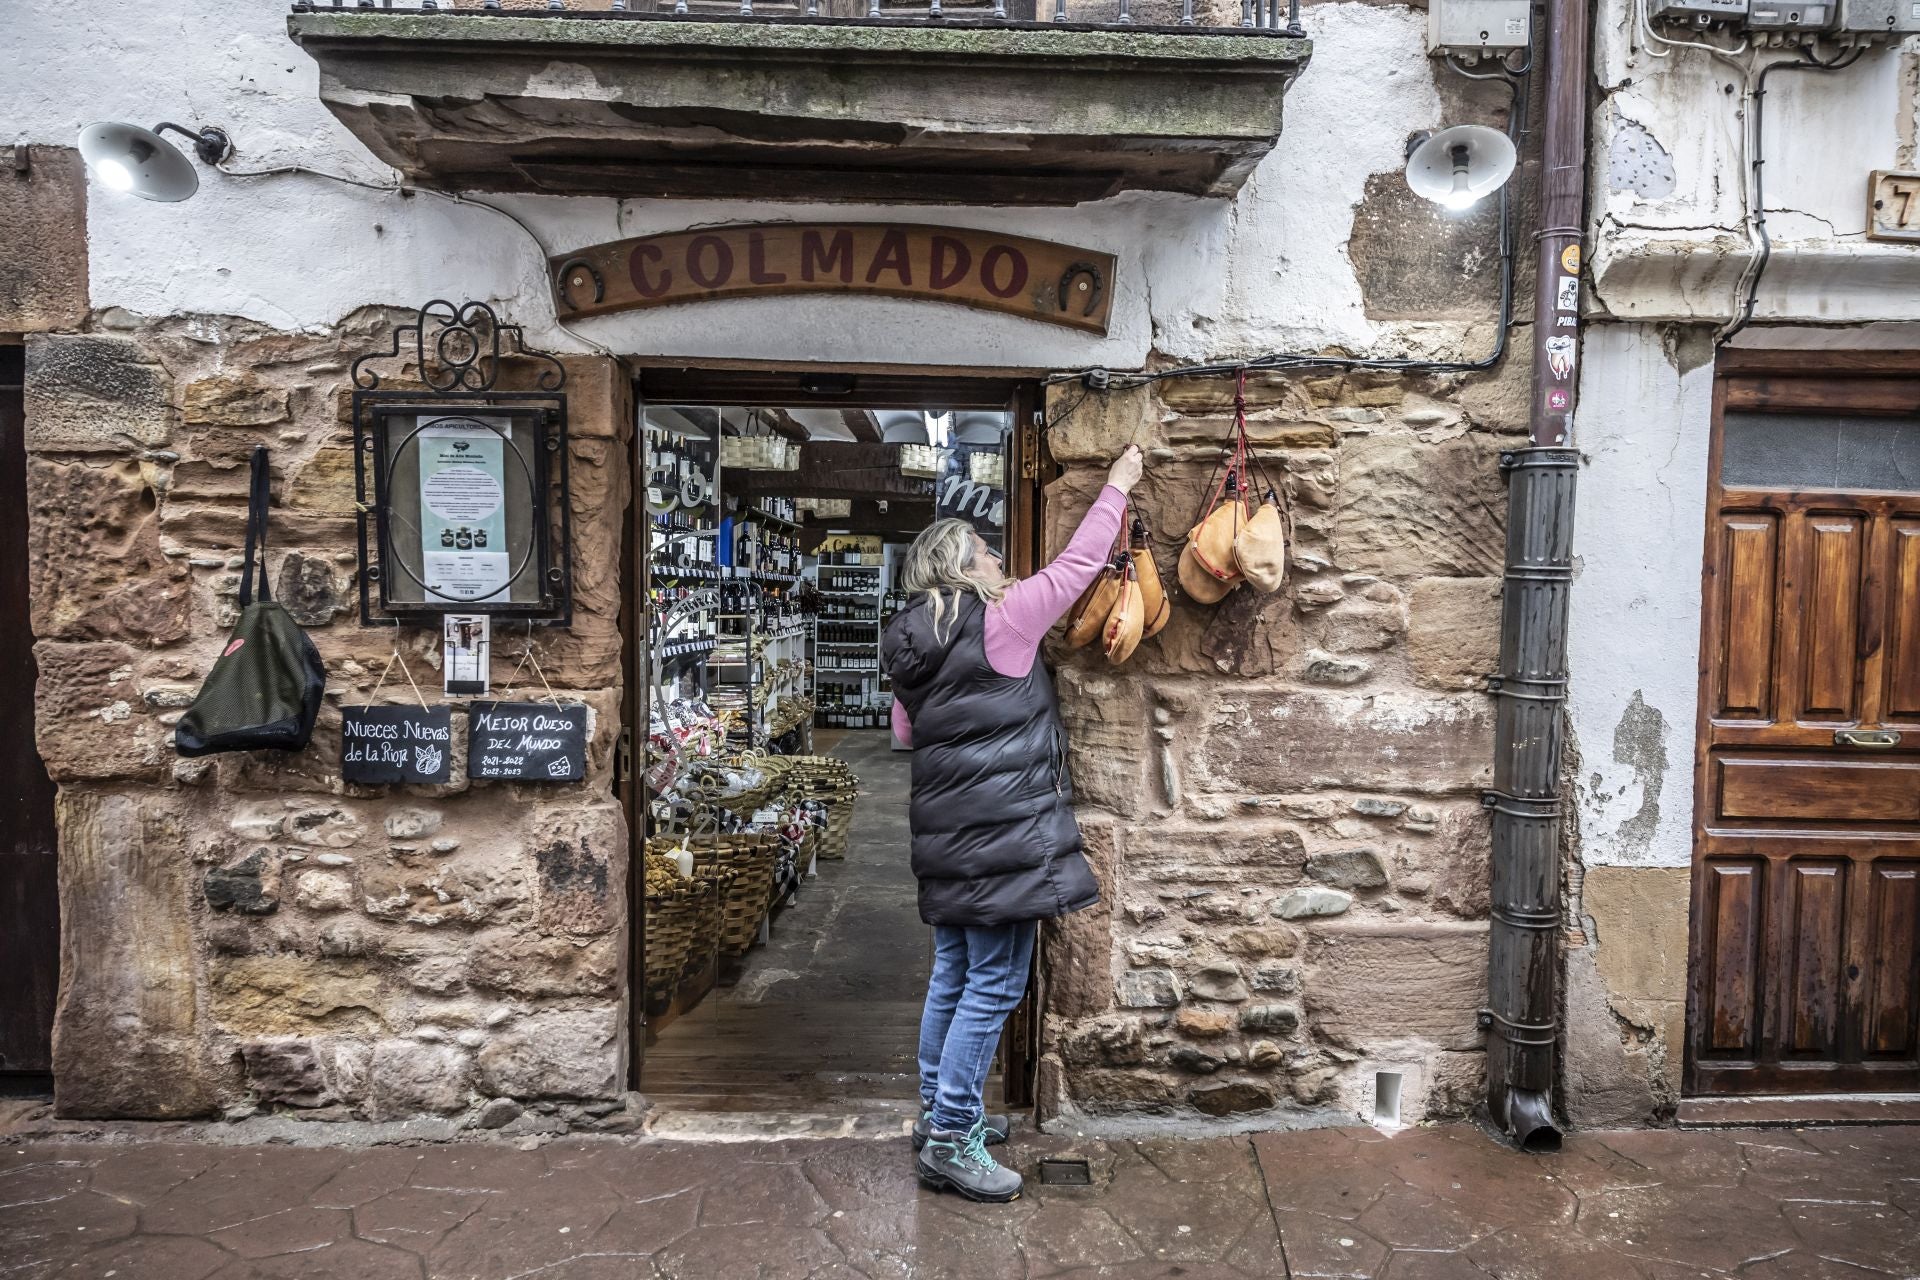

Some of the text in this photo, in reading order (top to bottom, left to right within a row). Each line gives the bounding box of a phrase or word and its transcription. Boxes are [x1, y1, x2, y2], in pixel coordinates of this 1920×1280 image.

[1893, 184, 1914, 228] 7
[629, 229, 1029, 299] COLMADO
[344, 719, 449, 740] Nueces Nuevas
[475, 713, 573, 732] MEJOR QUESO
[344, 741, 408, 768] de la Rioja
[487, 734, 561, 751] DEL MUNDO
